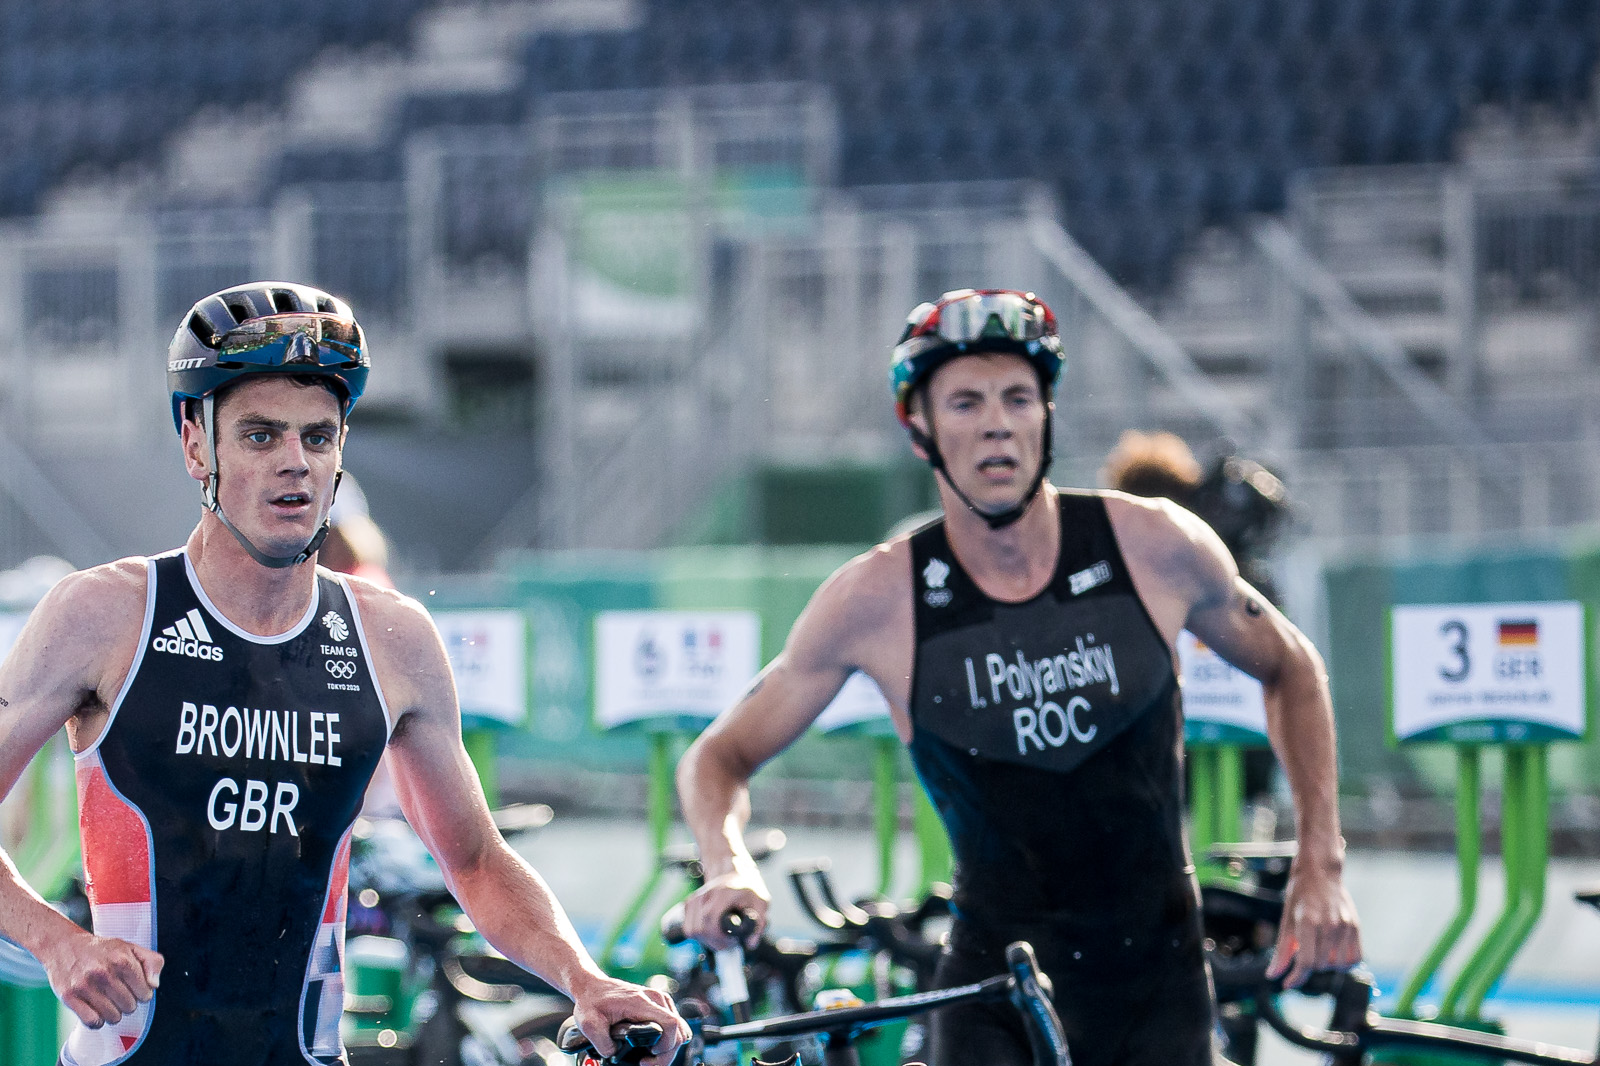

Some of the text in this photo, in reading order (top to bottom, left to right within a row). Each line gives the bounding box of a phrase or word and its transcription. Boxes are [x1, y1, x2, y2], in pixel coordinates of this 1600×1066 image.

[168, 357, 206, 371] SCOTT
[152, 636, 224, 662] adidas
[320, 644, 358, 657] TEAM GB
[986, 632, 1120, 711] Polyanskiy
[1439, 620, 1470, 682] 3
[326, 682, 360, 692] TOKYO 2020
[175, 701, 342, 767] BROWNLEE
[1012, 695, 1098, 756] ROC
[206, 777, 300, 837] GBR
